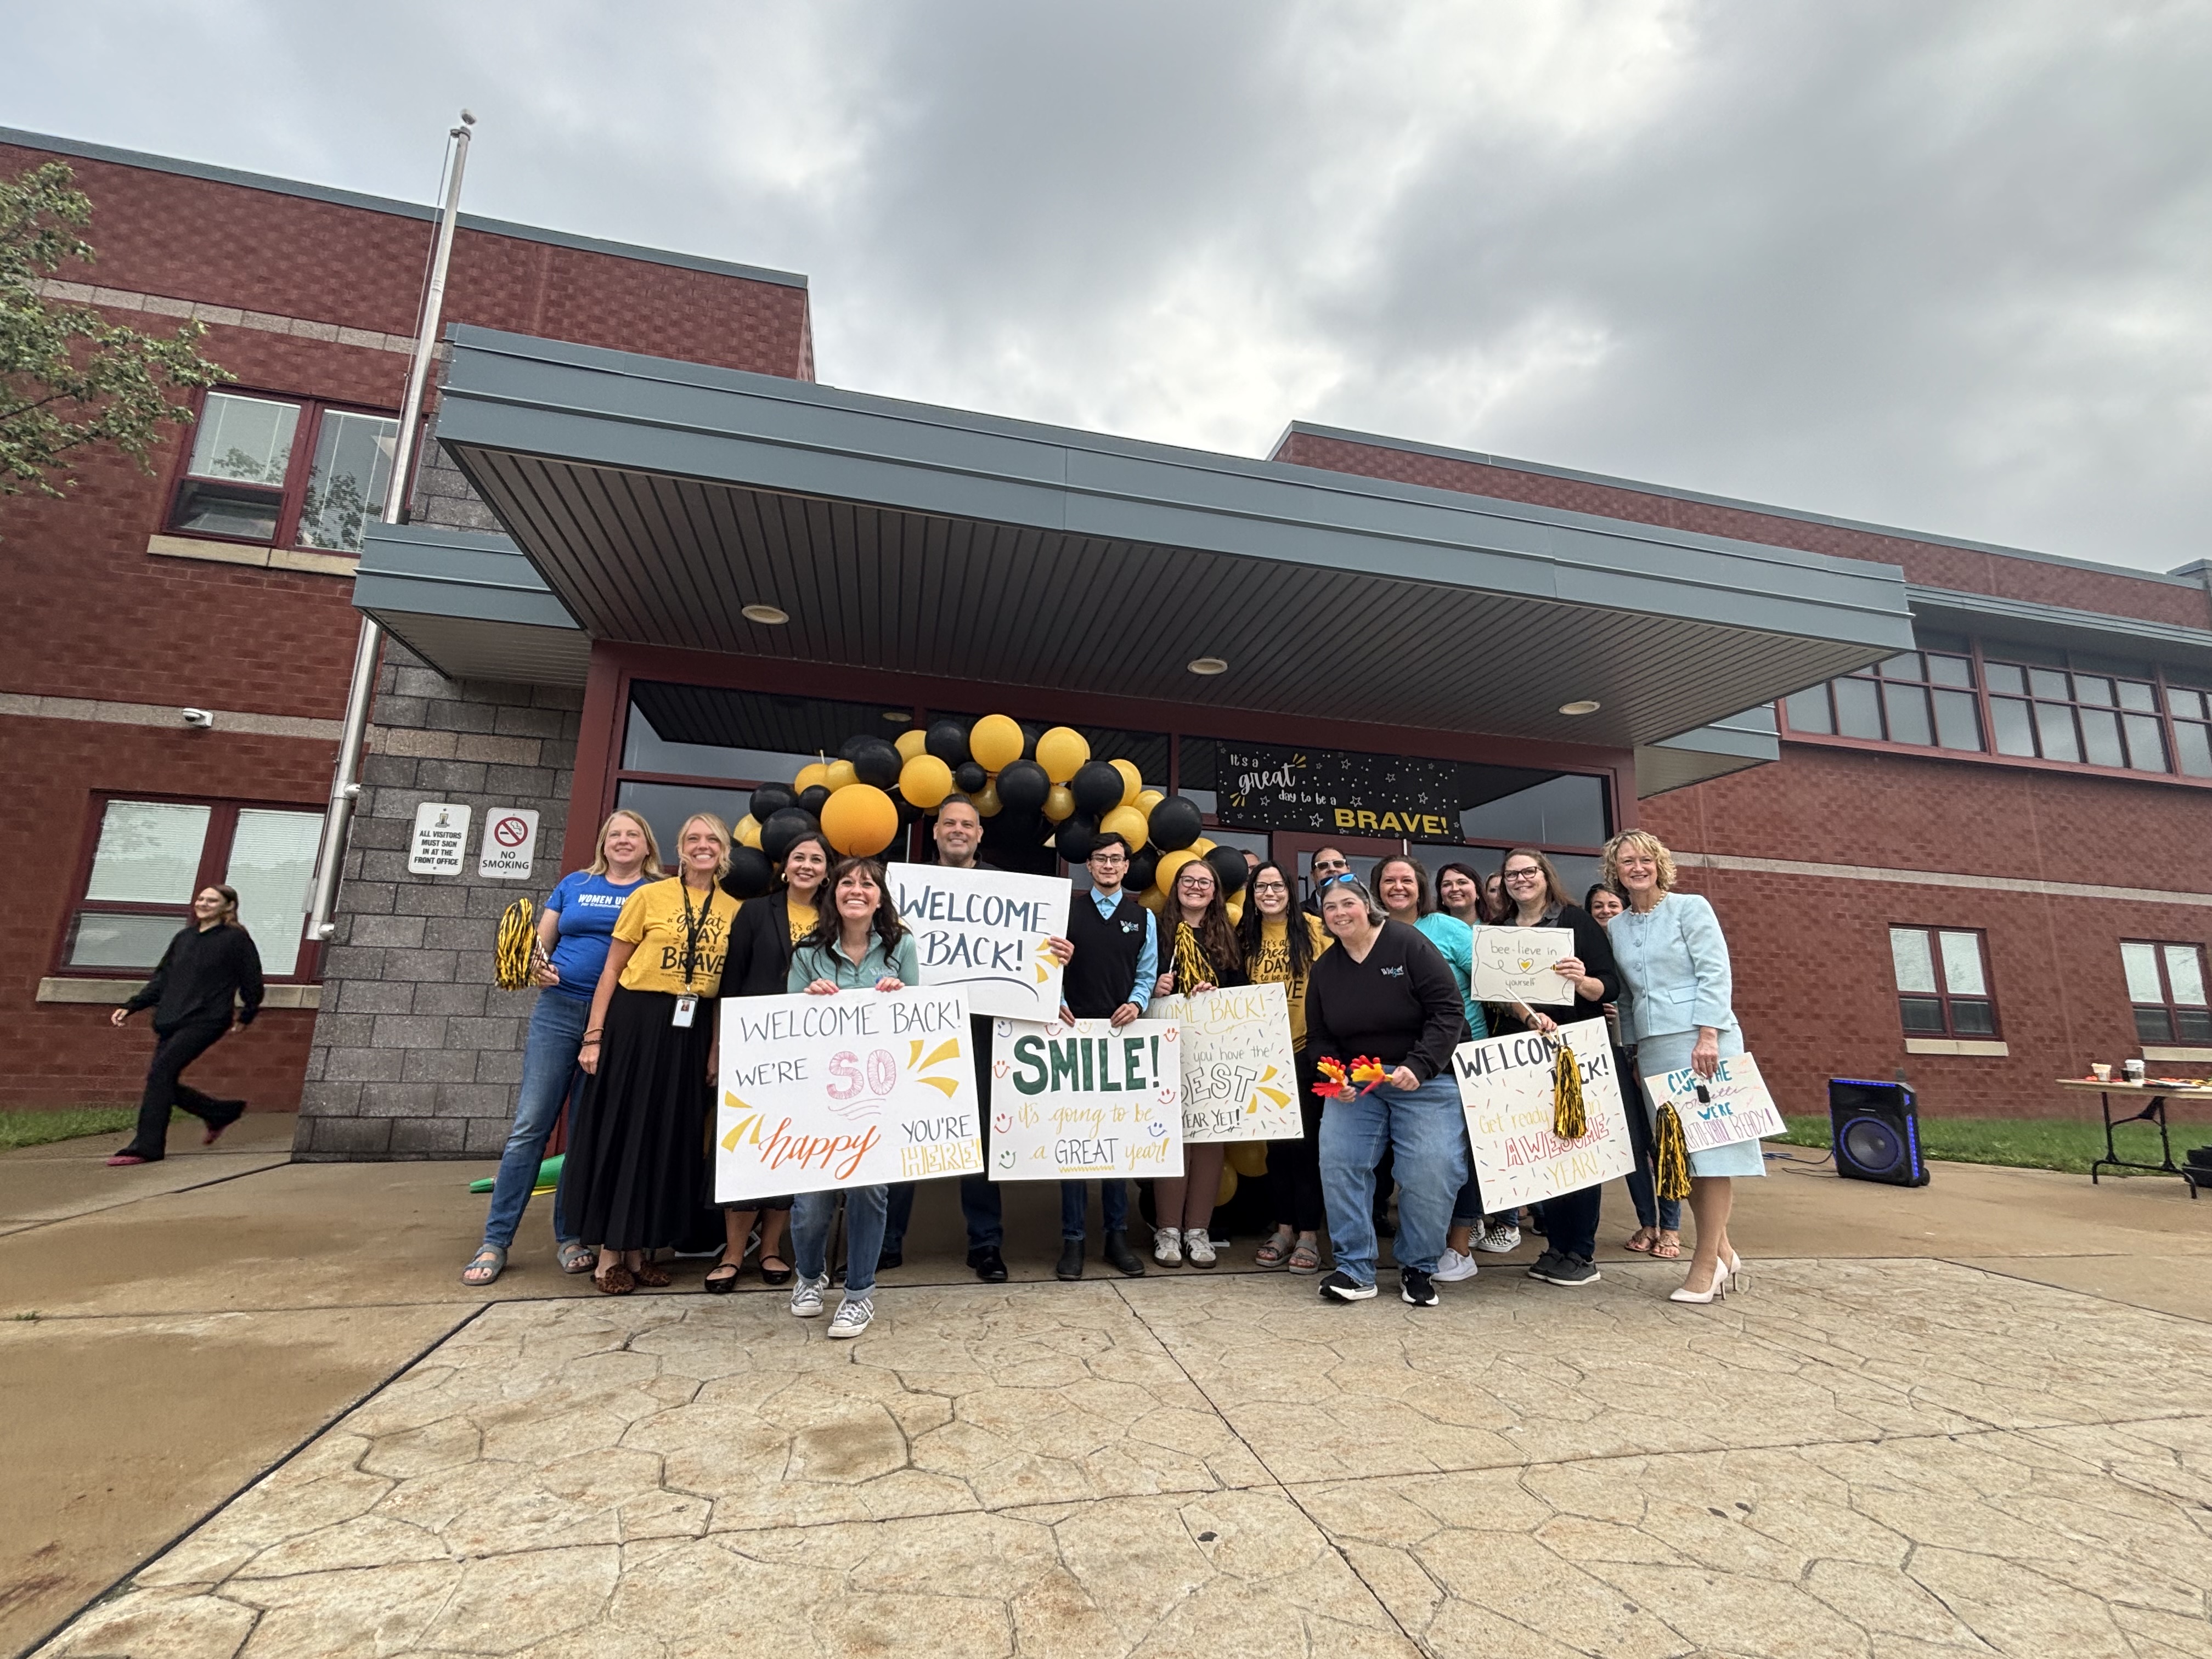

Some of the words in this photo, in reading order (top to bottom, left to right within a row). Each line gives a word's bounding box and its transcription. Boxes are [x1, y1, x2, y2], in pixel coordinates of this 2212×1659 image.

[1230, 754, 1248, 767] It's
[1252, 758, 1259, 768] a
[1239, 763, 1296, 795] great
[1278, 789, 1297, 803] day
[1301, 791, 1311, 803] to
[1316, 793, 1327, 805] be
[1330, 797, 1336, 805] a
[1334, 808, 1449, 835] BRAVE!
[433, 831, 461, 839] VISITORS
[482, 860, 529, 869] SMOKING
[500, 851, 516, 859] NO
[578, 894, 613, 905] WOMEN
[900, 883, 1051, 935] WELCOME
[676, 914, 727, 933] gat
[696, 928, 721, 944] AY
[919, 930, 1023, 972] BACK!
[1263, 939, 1277, 947] It's
[1547, 947, 1557, 956] in
[1264, 957, 1290, 974] DAY
[1505, 978, 1536, 989] yourself
[740, 1002, 879, 1042] WELCOME
[889, 999, 962, 1035] BACK!
[1209, 994, 1266, 1023] BACK!
[1012, 1035, 1160, 1095] SMILE!
[1193, 1052, 1212, 1068] you
[1219, 1047, 1244, 1060] have
[1250, 1045, 1269, 1058] the
[736, 1058, 809, 1087] WE'RE
[826, 1049, 896, 1099] SO
[1708, 1060, 1733, 1084] HE
[1018, 1102, 1039, 1128] it's
[1048, 1107, 1106, 1139] going
[1110, 1103, 1129, 1122] to
[1134, 1103, 1155, 1122] be
[1182, 1109, 1209, 1128] YEAR
[1211, 1109, 1240, 1126] YET!
[1479, 1113, 1504, 1134] Get
[1511, 1106, 1550, 1131] ready
[1697, 1102, 1733, 1120] WE'RE
[1729, 1108, 1776, 1139] READY!
[901, 1115, 973, 1143] YOU'RE
[758, 1118, 882, 1181] happy
[901, 1138, 983, 1178] HERE!
[1029, 1145, 1047, 1160] a
[1055, 1138, 1119, 1164] GREAT
[1125, 1137, 1170, 1171] year!
[1547, 1150, 1599, 1189] YEAR!
